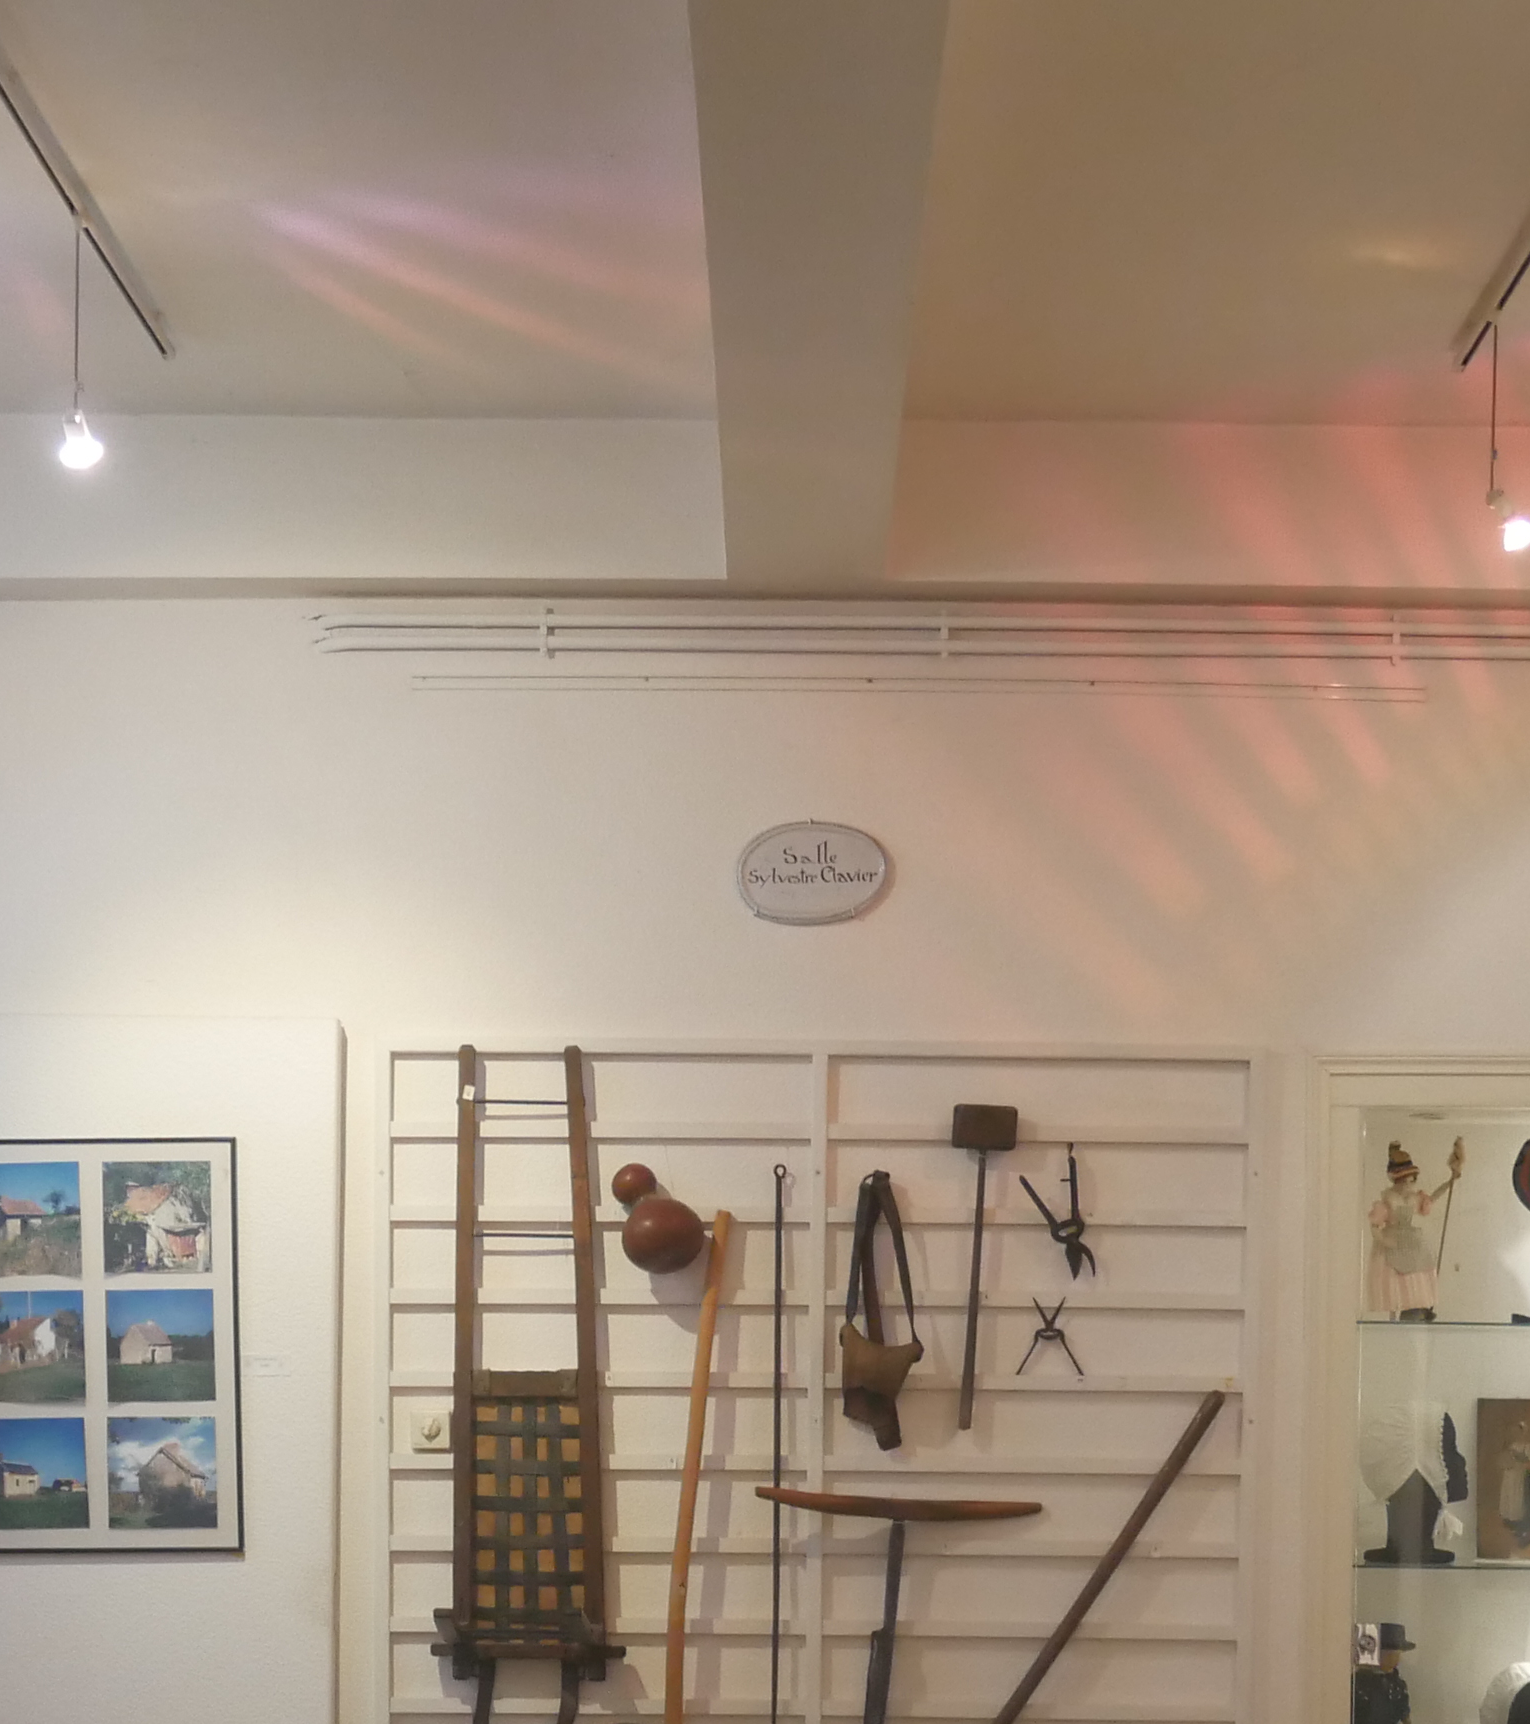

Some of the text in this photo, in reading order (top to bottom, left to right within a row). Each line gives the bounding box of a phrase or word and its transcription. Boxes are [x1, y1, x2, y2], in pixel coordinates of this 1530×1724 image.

[783, 840, 837, 864] Salle
[747, 865, 878, 887] Sylvestre Clavier
